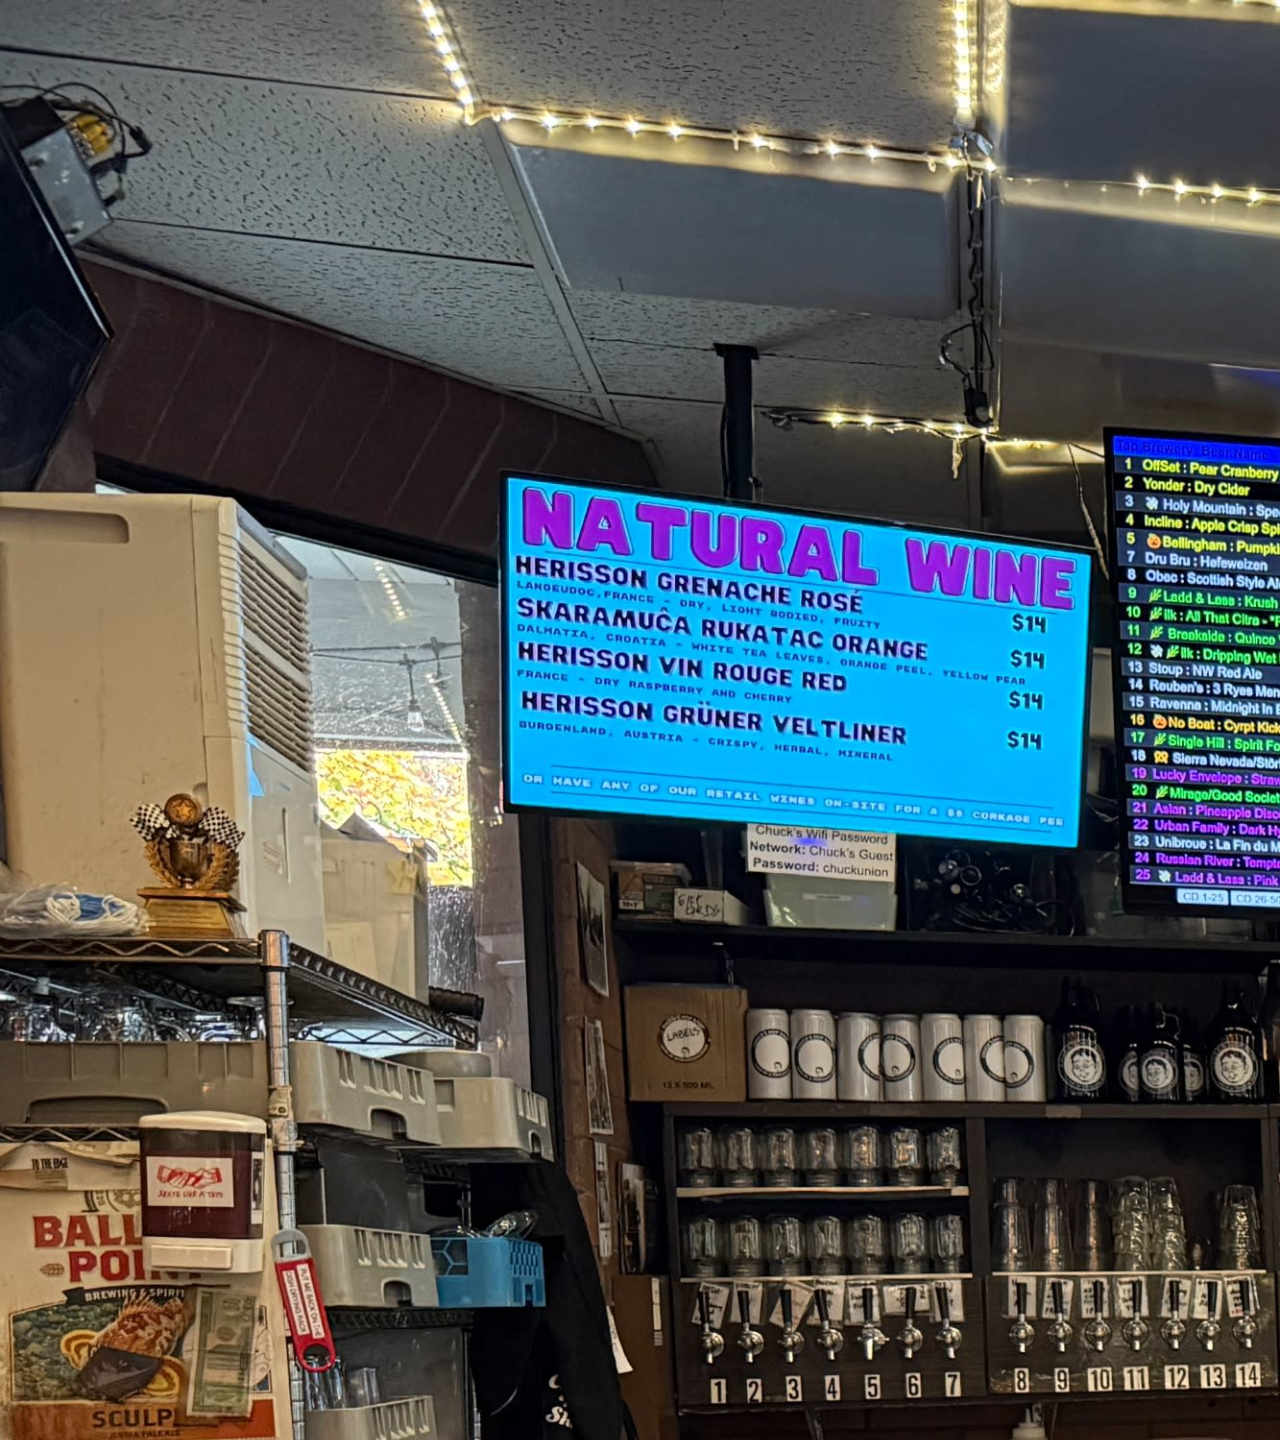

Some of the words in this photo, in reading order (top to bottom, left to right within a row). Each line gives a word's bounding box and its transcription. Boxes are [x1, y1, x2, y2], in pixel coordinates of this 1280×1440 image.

[1125, 459, 1132, 469] 1
[1190, 462, 1218, 476] Pear
[1221, 465, 1279, 482] Cranberry
[521, 487, 880, 586] NATURAL
[906, 537, 1077, 610] WINE
[516, 555, 647, 589] HERISSON
[657, 571, 793, 604] GRENACHE
[800, 589, 863, 614] ROSÉ
[1012, 614, 1047, 633] $14
[702, 620, 824, 649] RUKATAC
[831, 633, 928, 661] ORANGE
[1010, 650, 1044, 669] $14
[518, 642, 649, 673] HERISSON
[659, 656, 703, 678] VIN
[713, 662, 791, 687] ROUGE
[801, 672, 847, 691] RED
[1008, 691, 1043, 710] $14
[521, 691, 652, 722] HERISSON
[663, 699, 762, 731] GRÜNER
[773, 716, 906, 746] VELTLINER
[1007, 731, 1042, 751] $14
[755, 824, 803, 838] Chuck's
[806, 828, 827, 839] Wifi
[831, 831, 888, 845] Password
[750, 841, 805, 855] Network:
[809, 845, 855, 858] Chuck's
[859, 849, 893, 861] Guest
[753, 858, 819, 872] Password:
[823, 863, 888, 877] chuckunion
[33, 1215, 143, 1248] BALL
[84, 1288, 136, 1301] BREWING
[92, 1410, 173, 1429] SCULP
